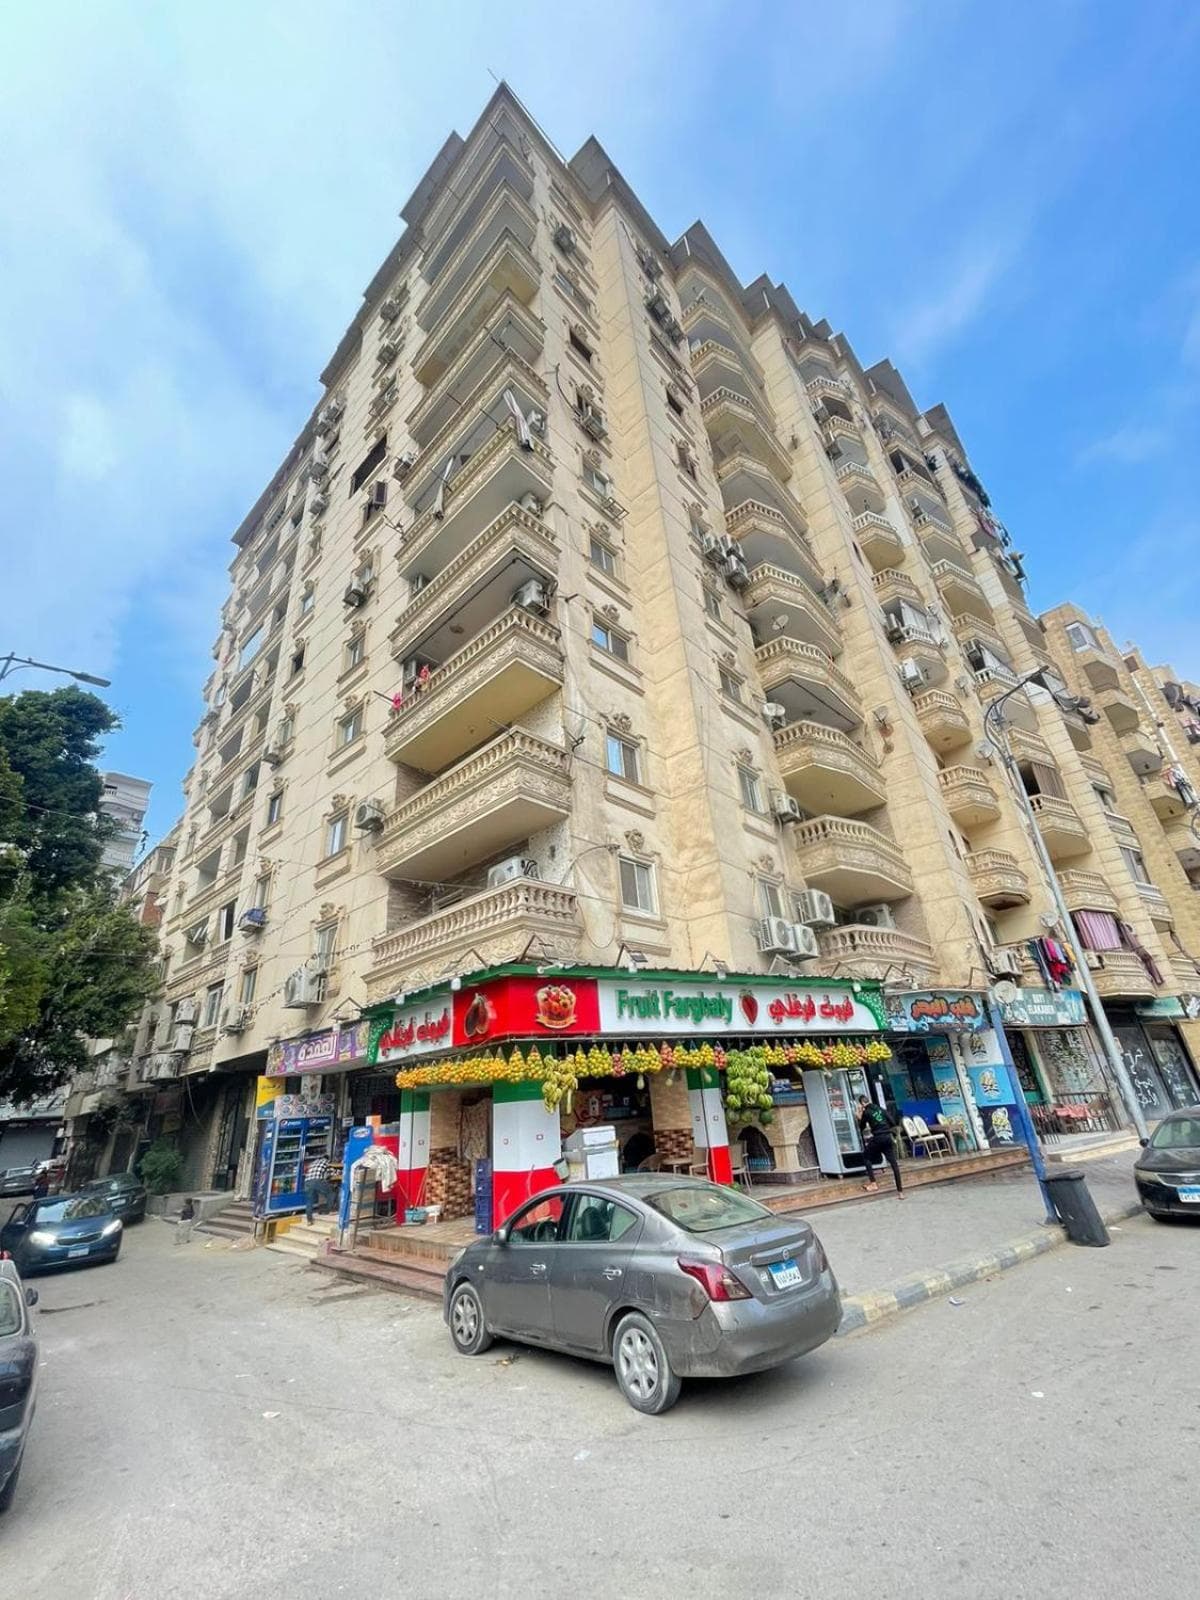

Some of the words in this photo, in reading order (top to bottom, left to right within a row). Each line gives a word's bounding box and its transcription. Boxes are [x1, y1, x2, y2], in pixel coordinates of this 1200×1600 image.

[615, 989, 660, 1019] Fruit
[660, 990, 733, 1025] Farghaly
[767, 993, 816, 1025] فرغلي
